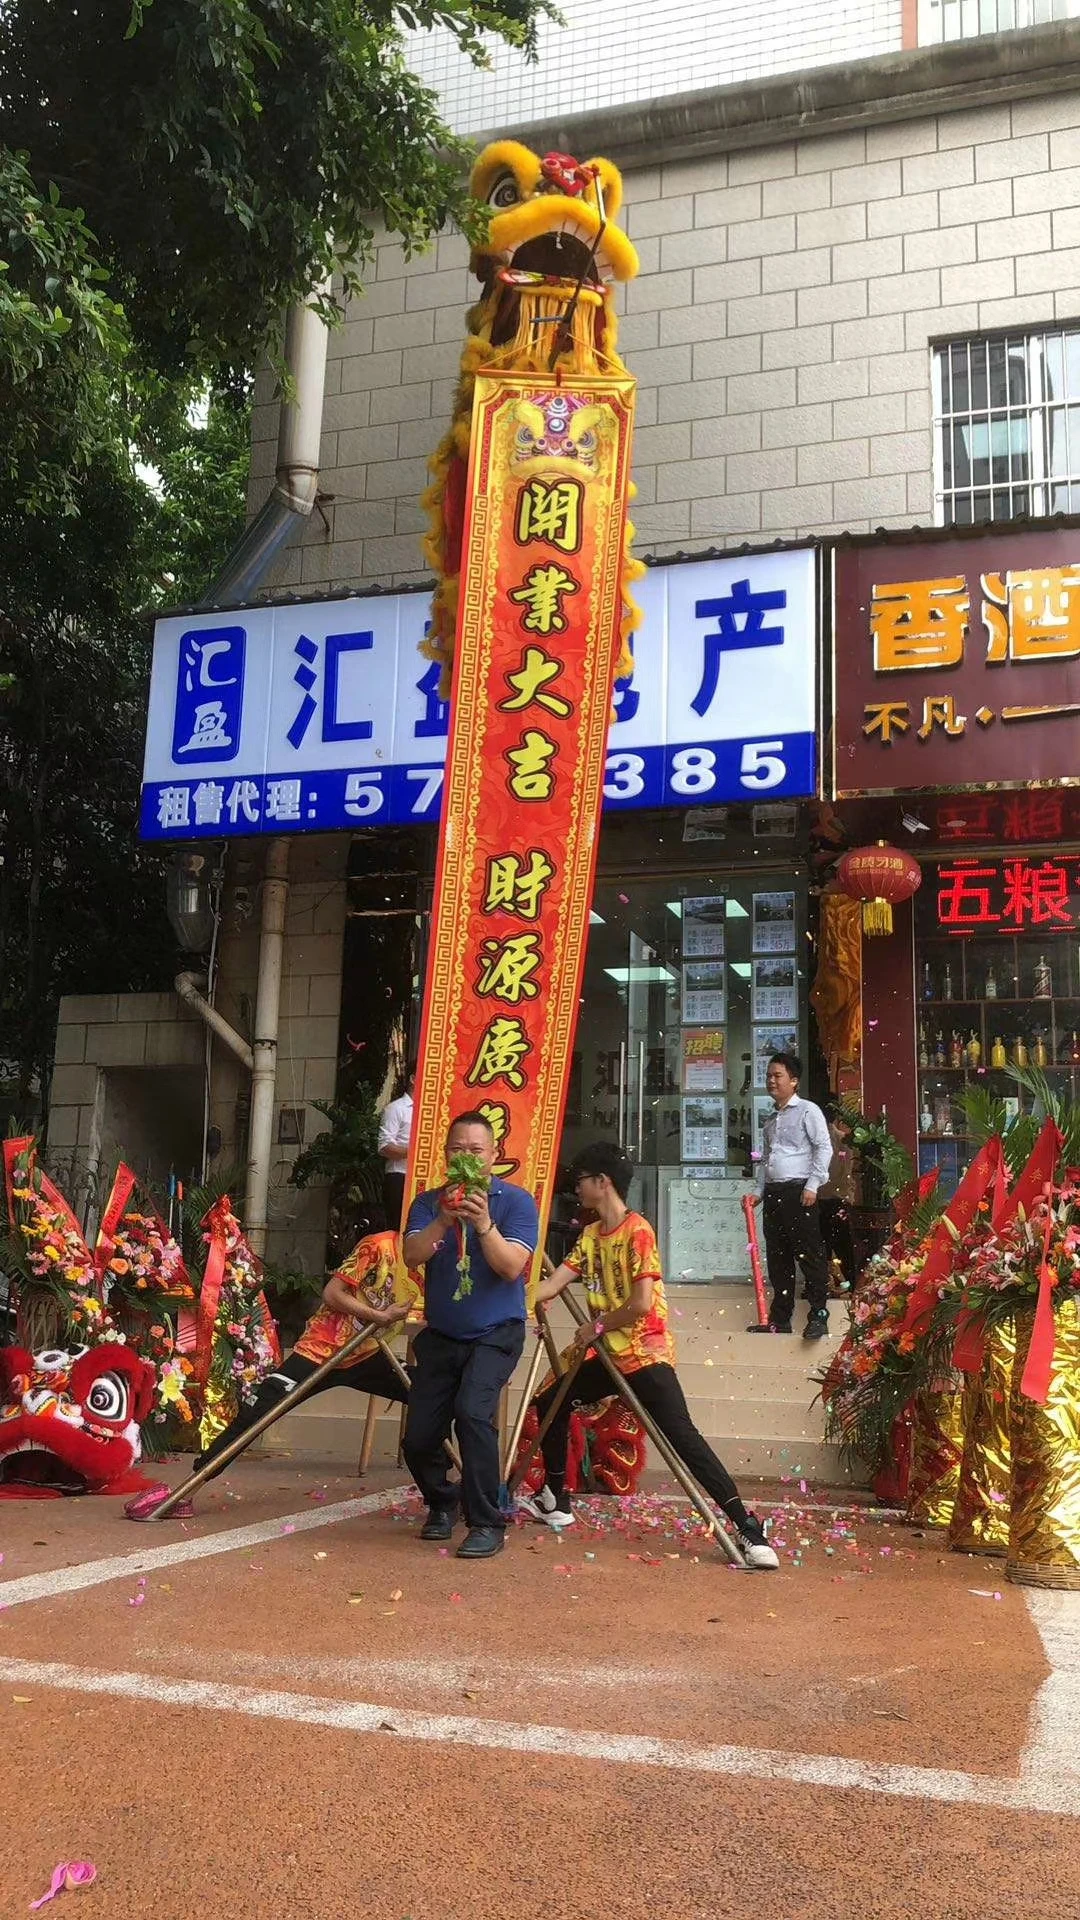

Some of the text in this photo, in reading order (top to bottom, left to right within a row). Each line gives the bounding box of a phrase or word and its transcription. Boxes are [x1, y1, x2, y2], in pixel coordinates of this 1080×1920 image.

[287, 578, 787, 750] 汇产
[498, 478, 585, 802] 開業大吉
[870, 564, 1080, 671] 香酒
[178, 638, 237, 753] 汇盈
[937, 860, 1080, 924] 五粮
[684, 1033, 725, 1056] 招聘
